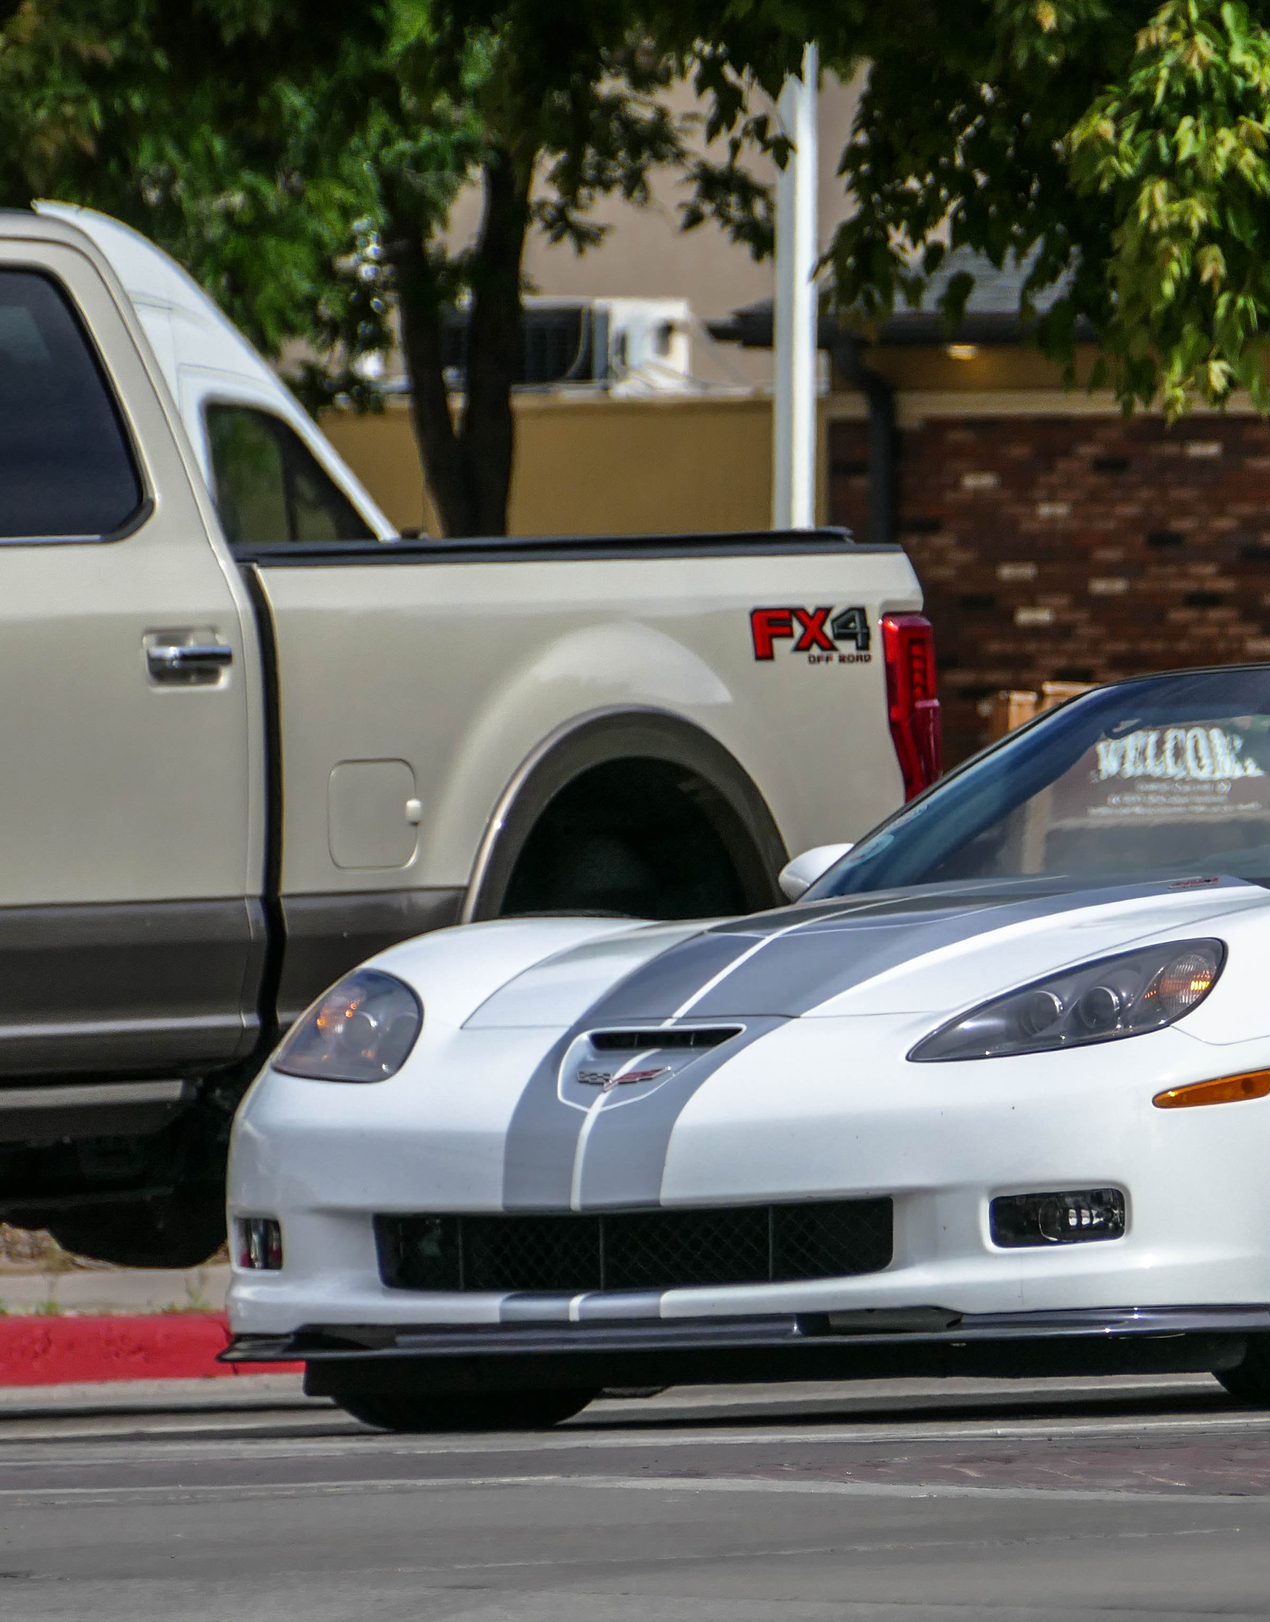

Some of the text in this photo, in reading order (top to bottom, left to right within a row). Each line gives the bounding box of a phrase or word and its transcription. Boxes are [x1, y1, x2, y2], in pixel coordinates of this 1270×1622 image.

[750, 605, 871, 662] FX4
[808, 653, 872, 664] OFF ROAD
